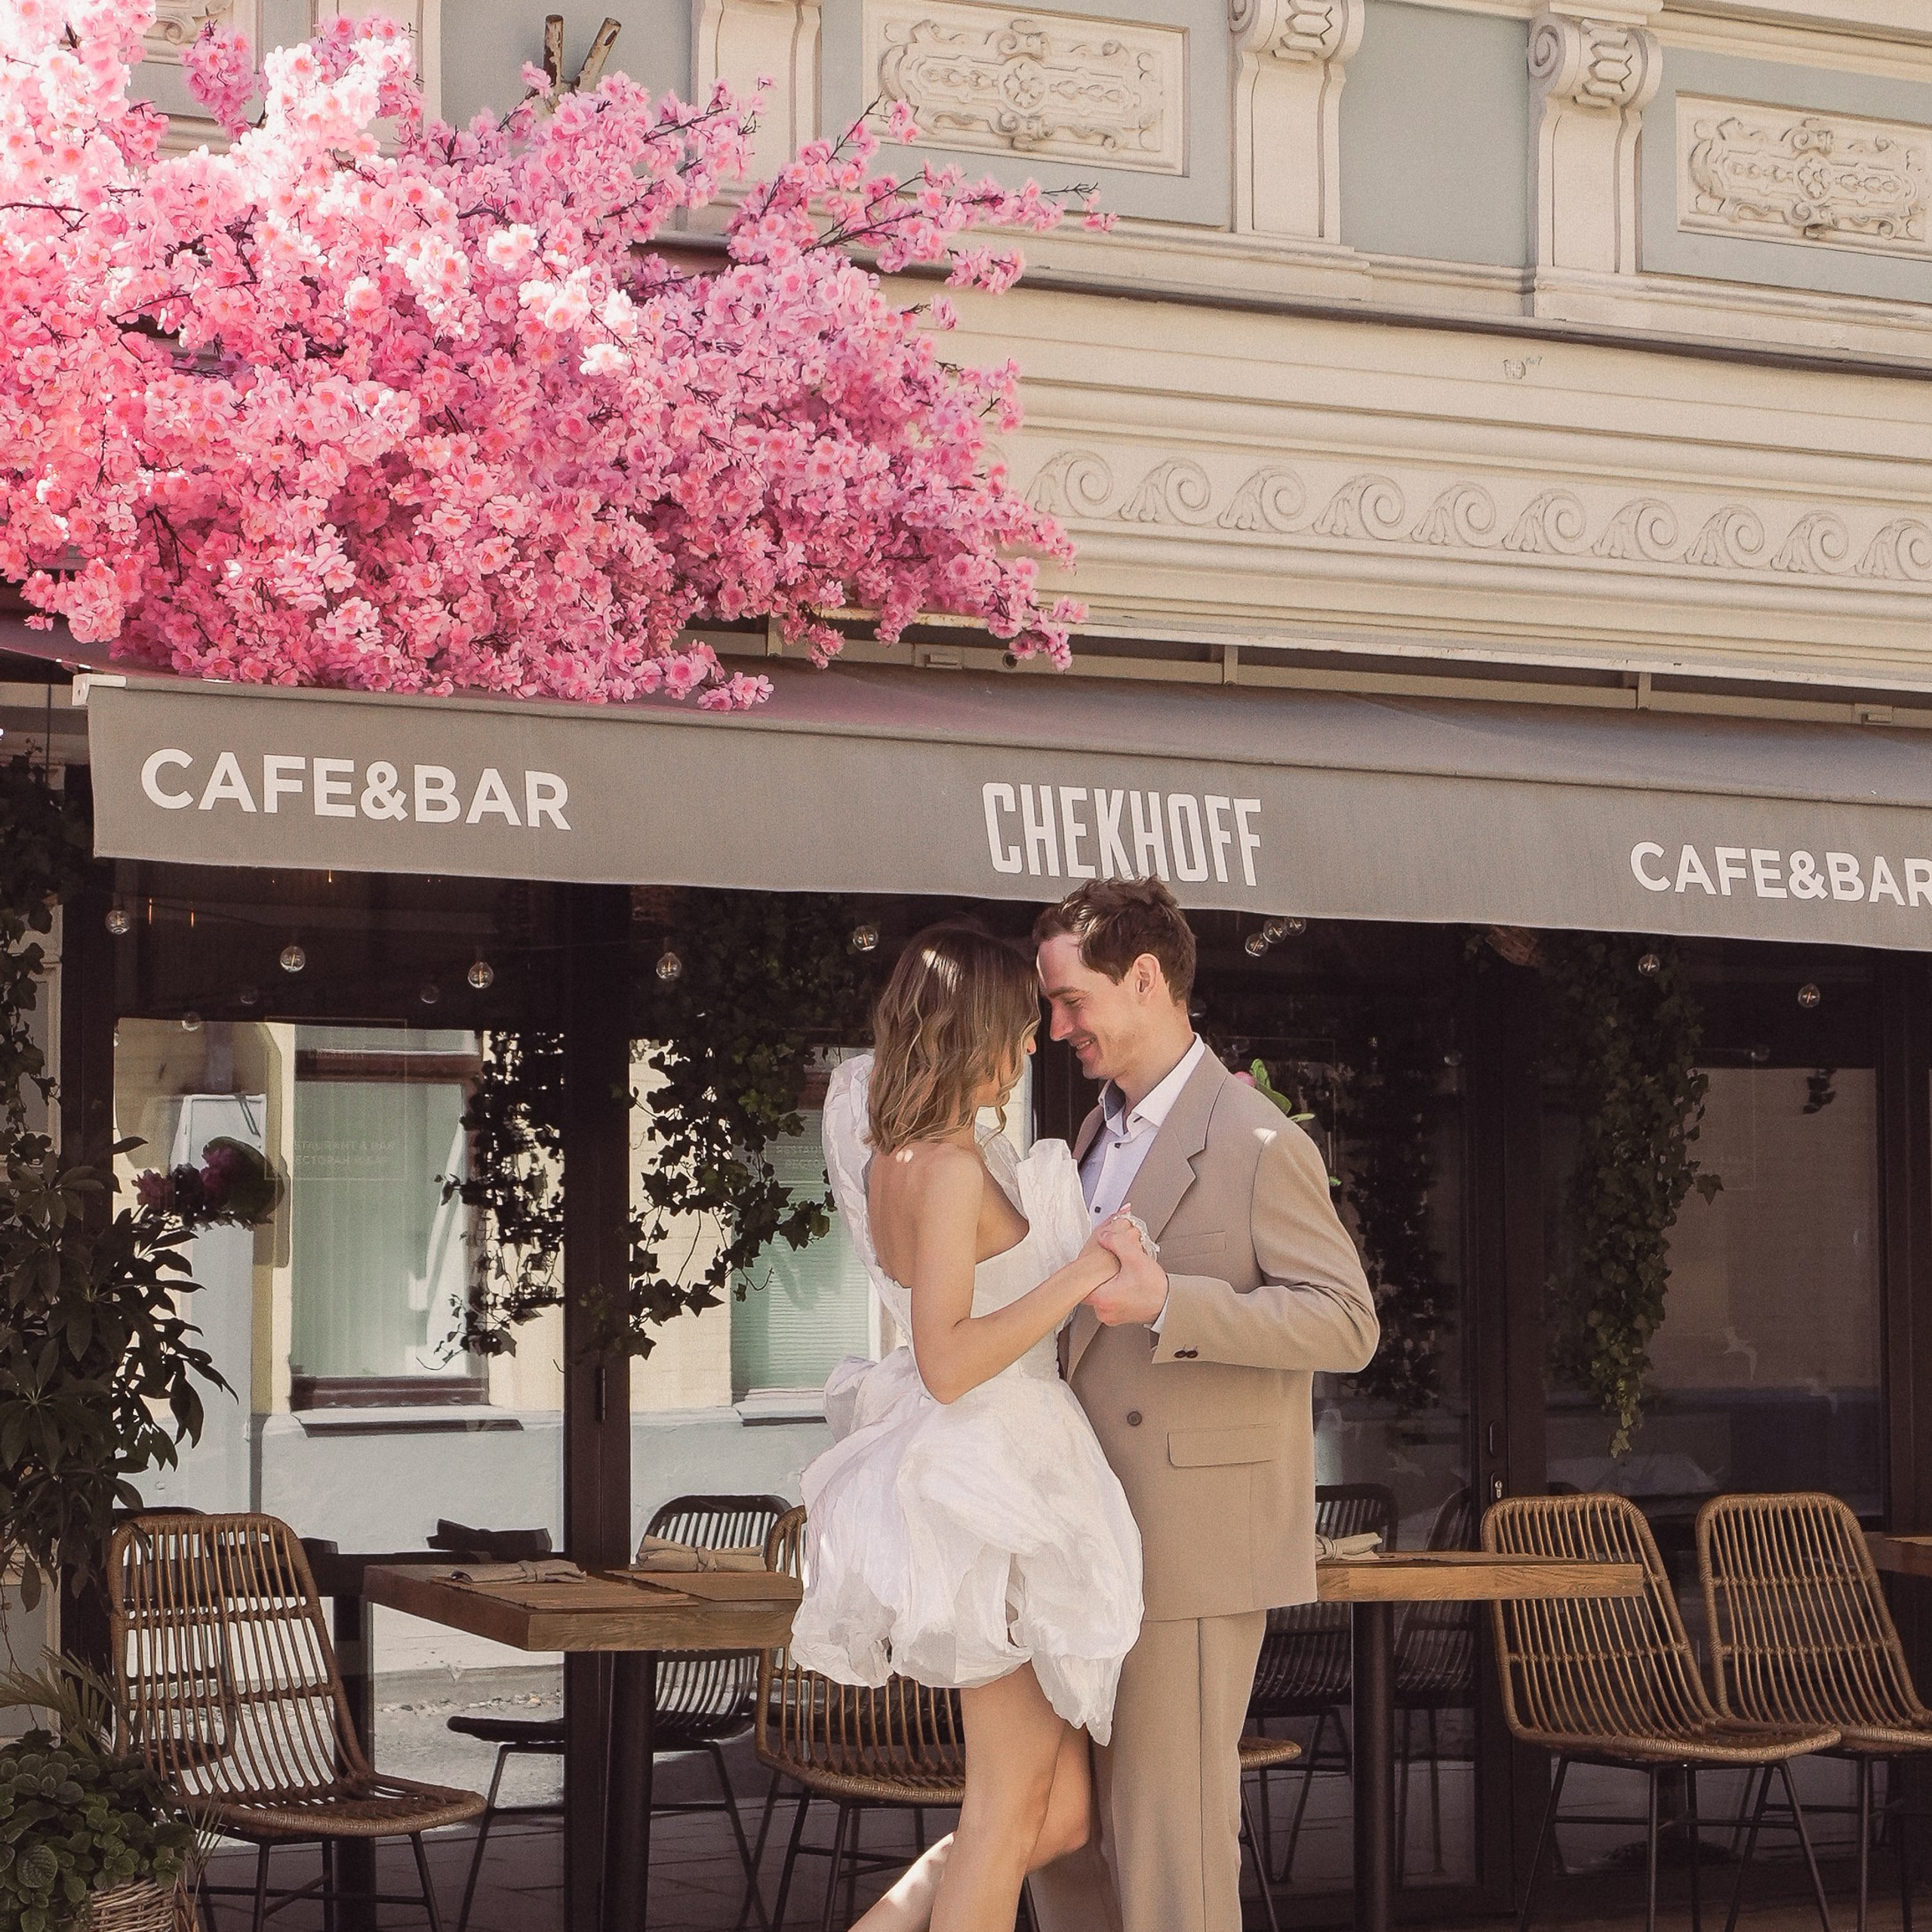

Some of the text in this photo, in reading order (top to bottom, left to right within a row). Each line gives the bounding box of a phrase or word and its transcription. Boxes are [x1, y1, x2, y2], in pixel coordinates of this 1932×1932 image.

[140, 748, 572, 830] CAFE&BAR
[982, 783, 1261, 886] CHEKHOFF
[1630, 841, 1932, 908] CAFE&BAR
